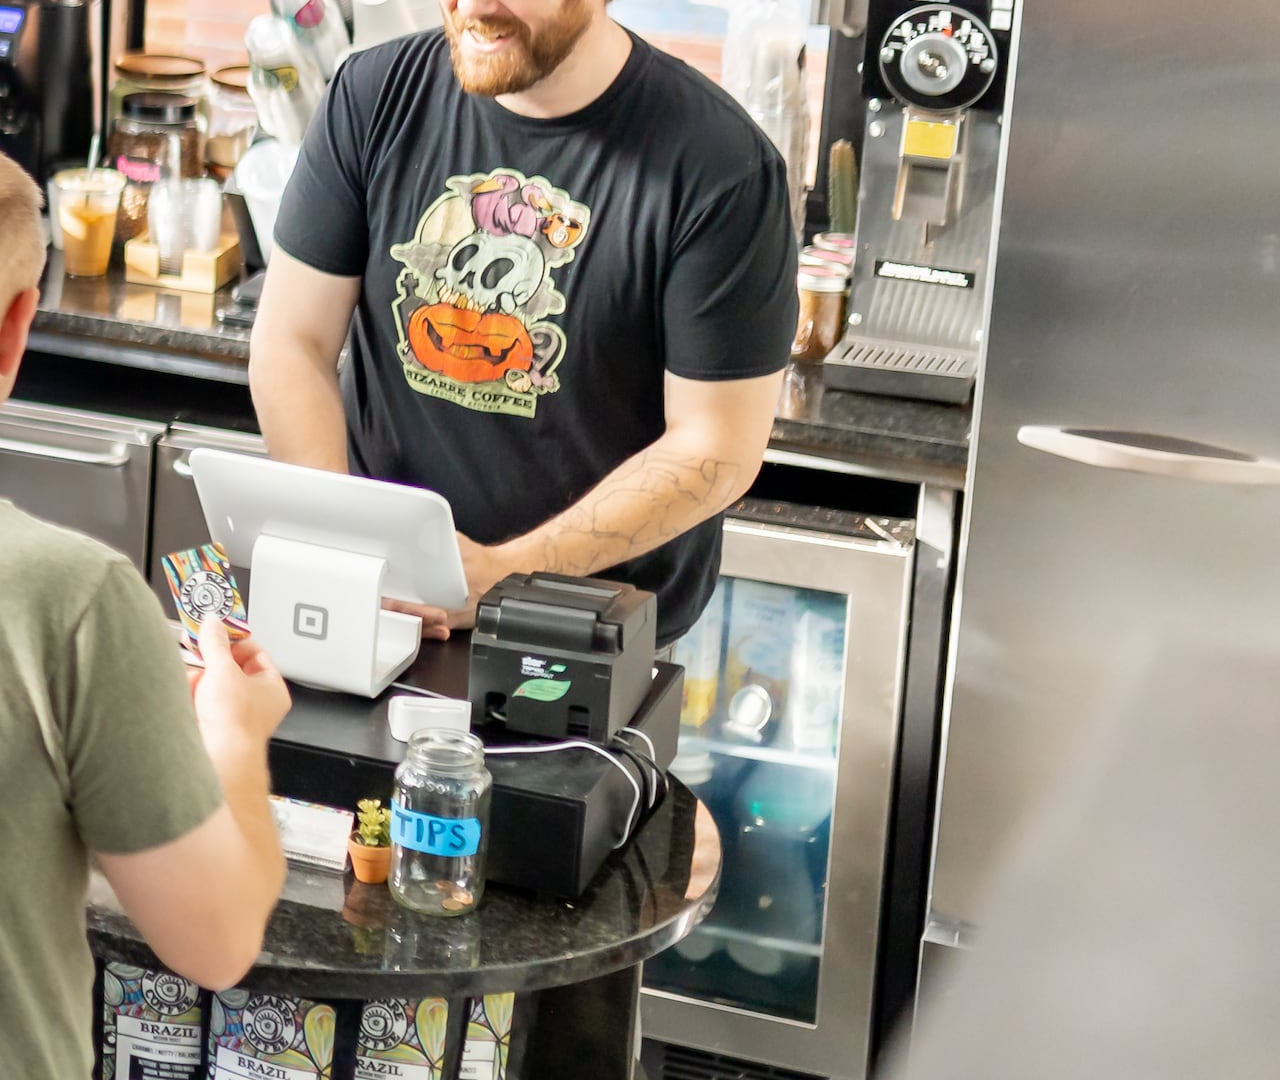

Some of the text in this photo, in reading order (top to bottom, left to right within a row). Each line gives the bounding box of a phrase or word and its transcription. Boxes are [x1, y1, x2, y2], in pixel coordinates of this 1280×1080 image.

[471, 391, 534, 410] COFFEE
[394, 808, 467, 852] TIPS
[144, 988, 195, 1015] COFFEE
[140, 1021, 199, 1040] BRAZIL
[244, 1022, 290, 1052] COFFEE
[358, 1029, 401, 1051] OFFEE
[237, 1055, 291, 1080] BRAZIL
[357, 1056, 404, 1077] RAZIL
